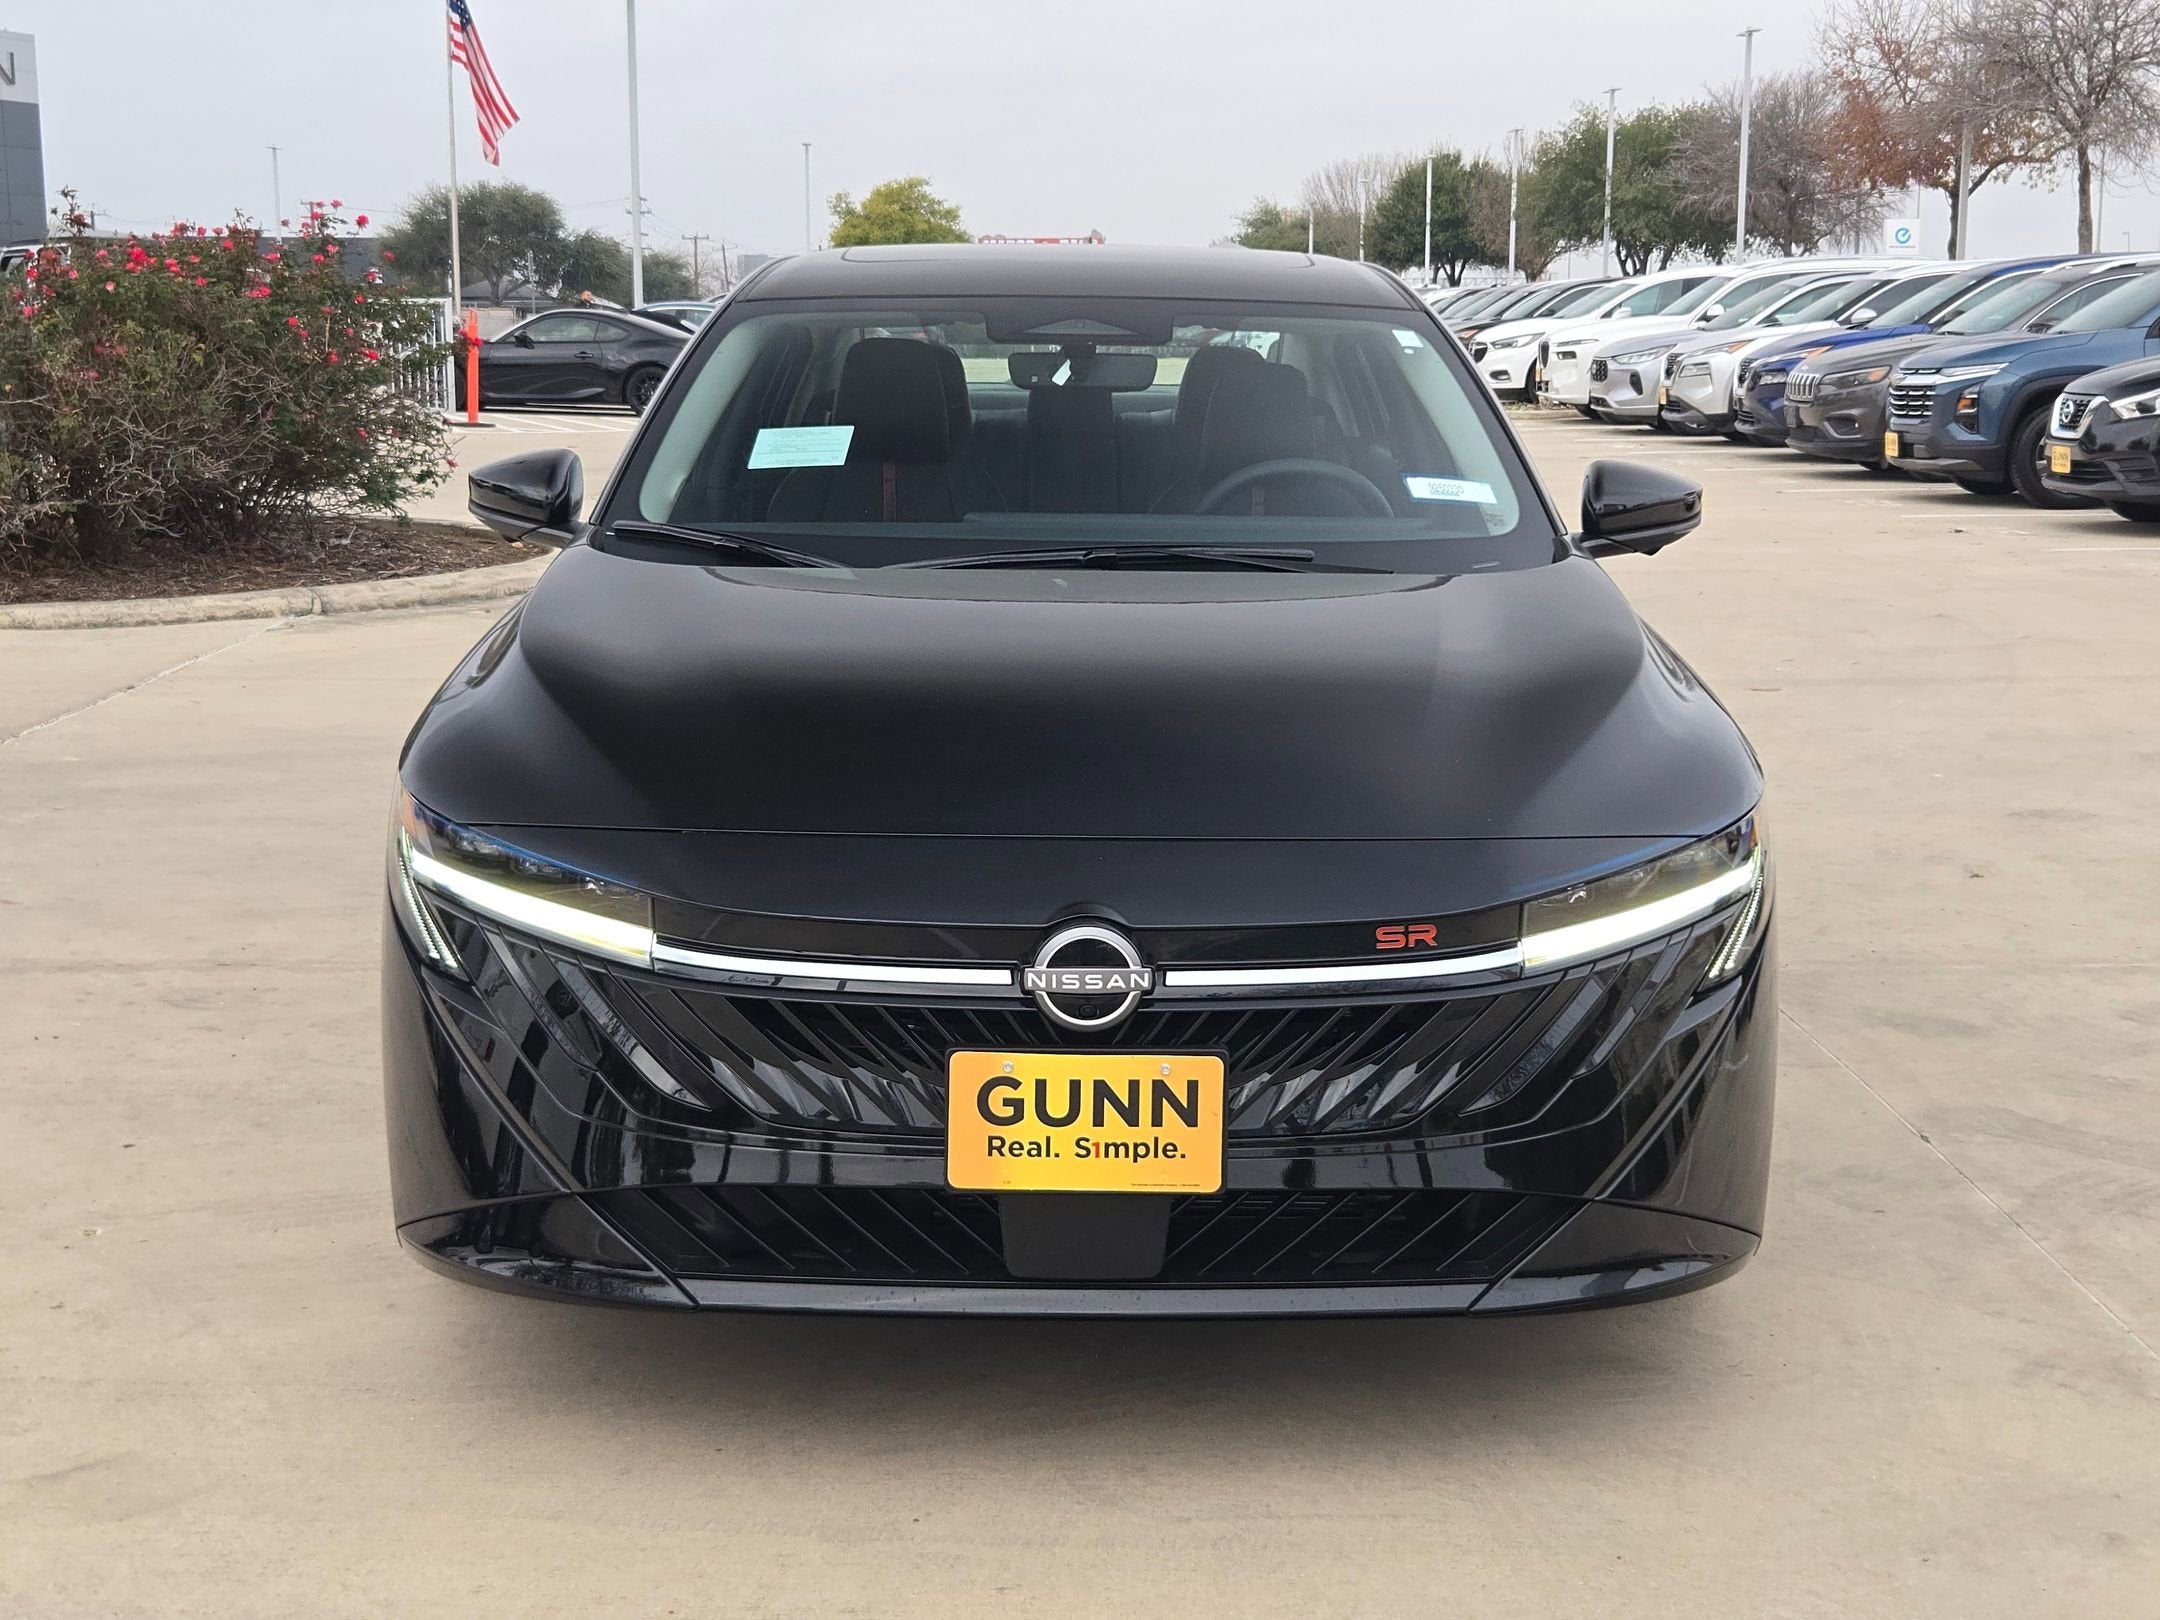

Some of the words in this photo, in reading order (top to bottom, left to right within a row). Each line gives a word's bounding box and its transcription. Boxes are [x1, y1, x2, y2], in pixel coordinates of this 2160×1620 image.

[1376, 924, 1438, 949] SR
[1027, 972, 1149, 989] NISSAN
[976, 1075, 1199, 1127] GUNN
[987, 1135, 1060, 1158] Real.
[1074, 1136, 1186, 1163] S1mple.
